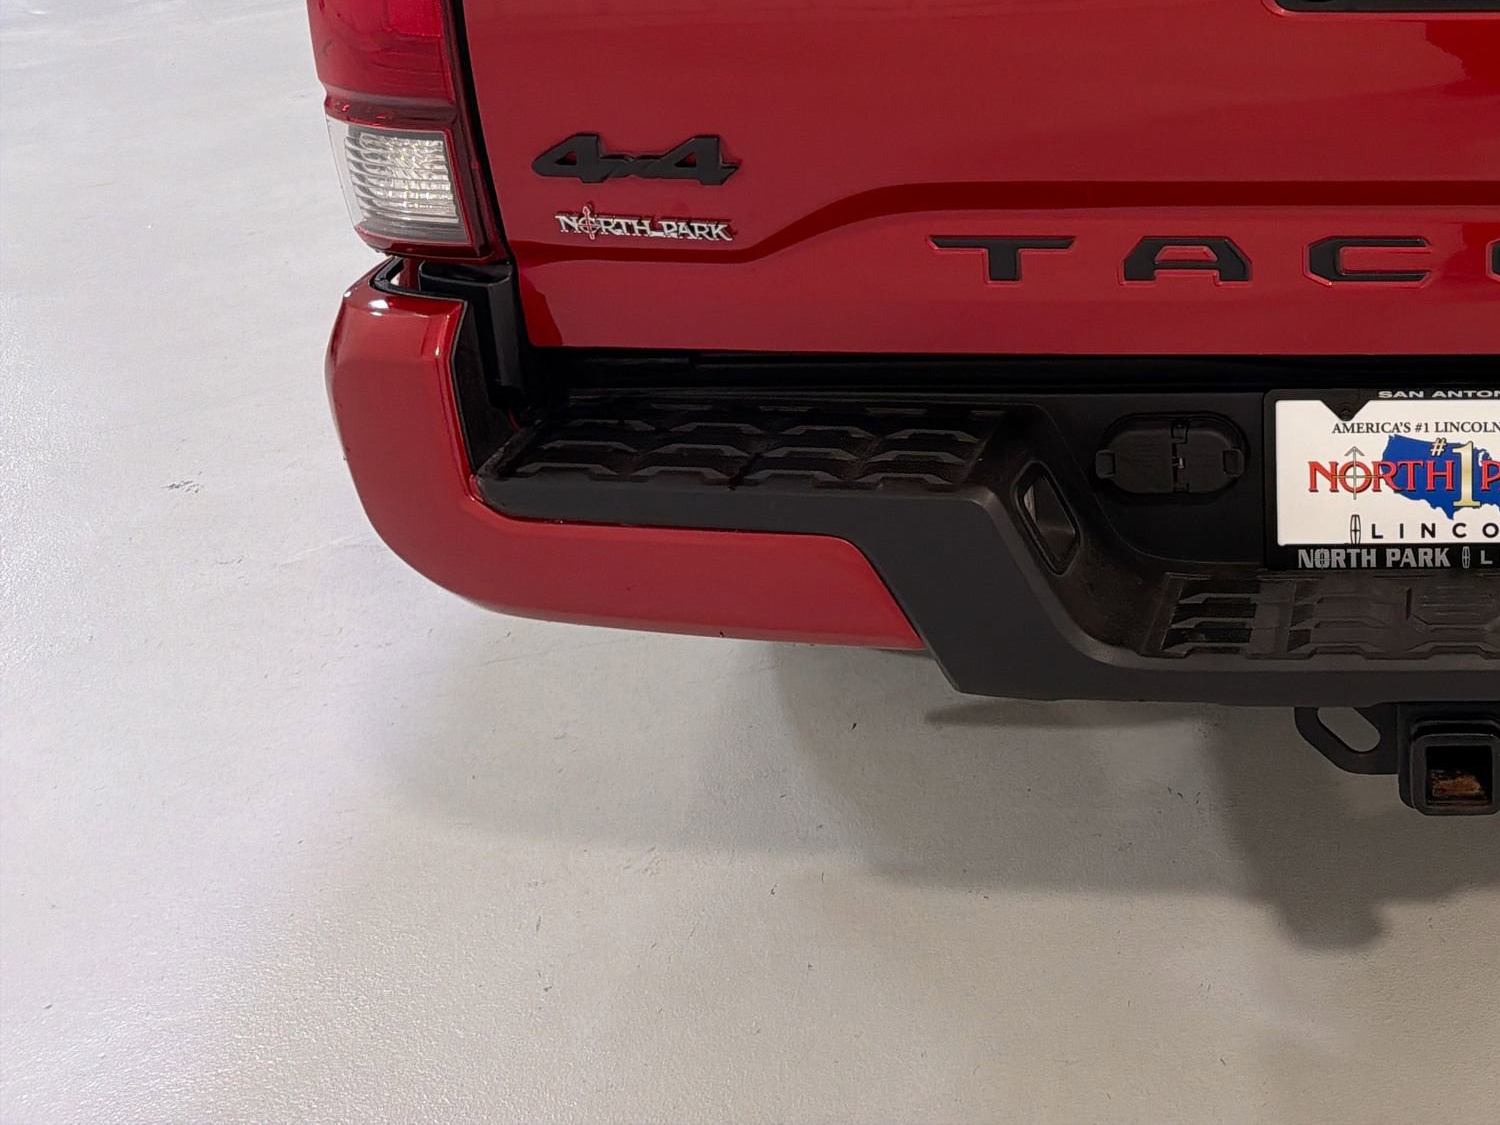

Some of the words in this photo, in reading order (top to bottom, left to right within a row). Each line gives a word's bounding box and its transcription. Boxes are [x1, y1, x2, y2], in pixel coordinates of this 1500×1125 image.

[531, 132, 740, 186] 4x4
[555, 210, 652, 239] NORTH
[659, 220, 733, 241] PARK
[1378, 390, 1424, 398] SAN
[1332, 422, 1411, 434] AMERICA'S
[1415, 422, 1429, 433] #1
[1308, 458, 1455, 493] NORTH
[1298, 547, 1377, 569] NORTH
[1386, 547, 1451, 568] PARK
